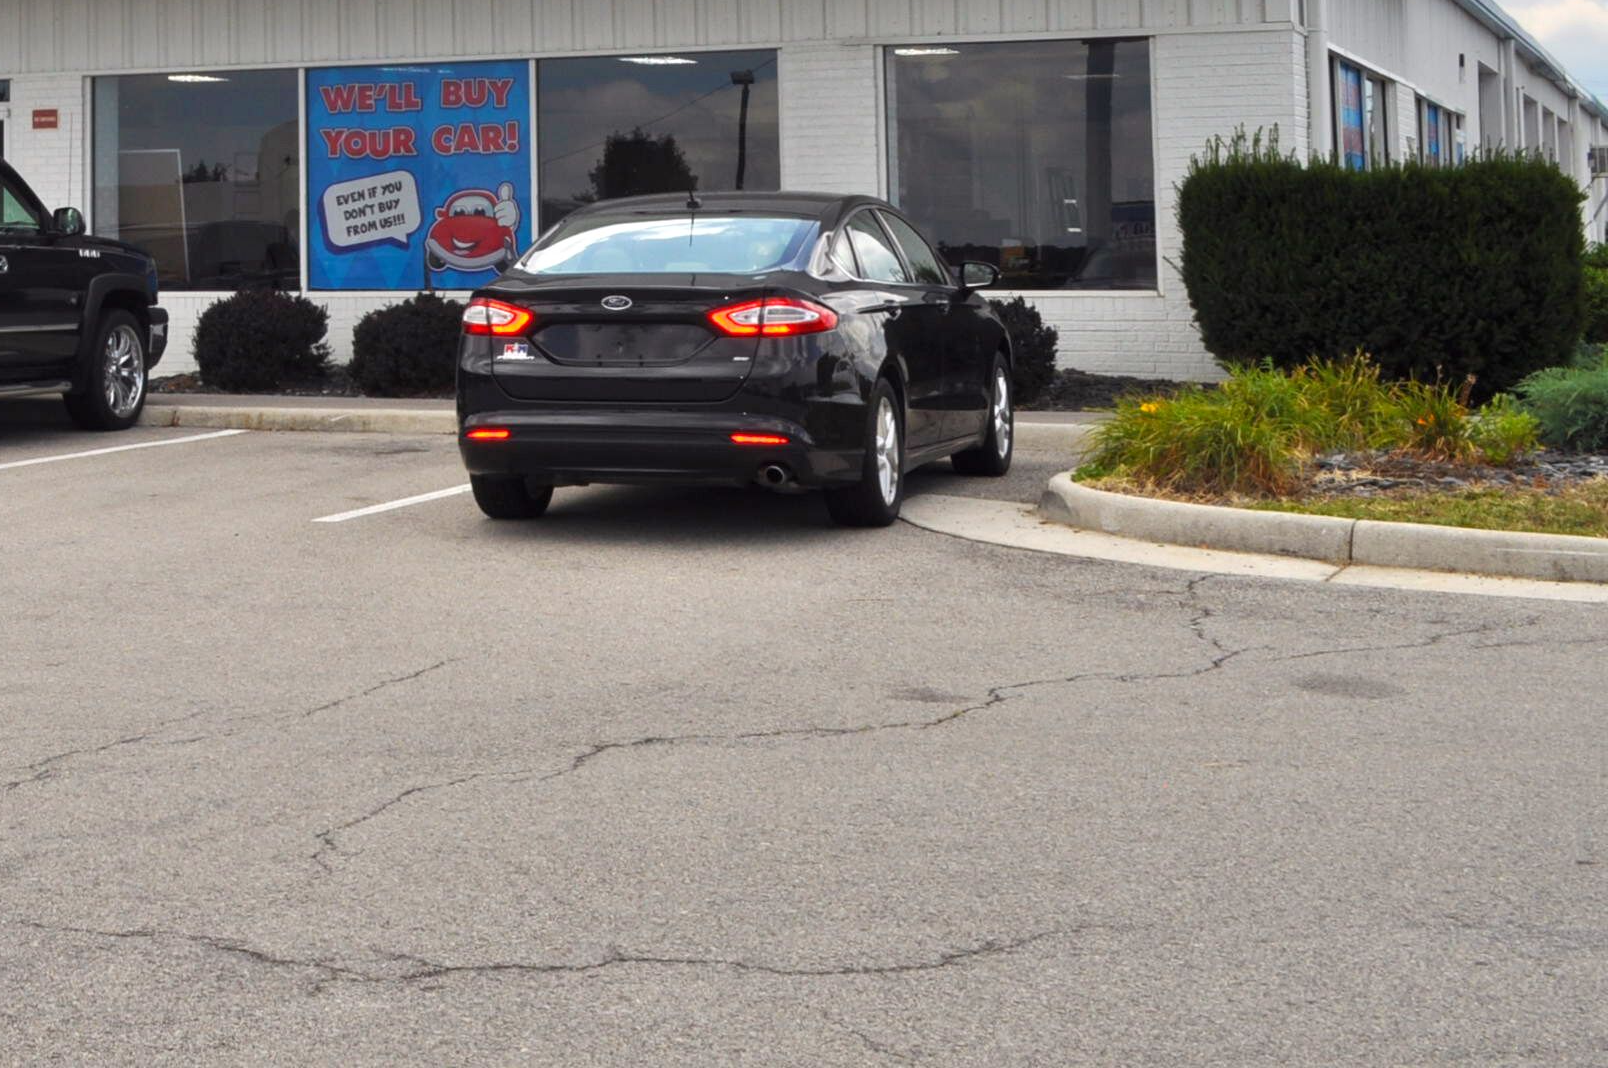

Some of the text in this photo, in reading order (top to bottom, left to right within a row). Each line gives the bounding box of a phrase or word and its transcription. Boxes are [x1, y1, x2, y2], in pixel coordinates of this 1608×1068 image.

[320, 79, 514, 114] WE'LL BUY
[320, 121, 520, 159] YOUR CAR!
[336, 189, 365, 206] EVEN
[381, 181, 402, 196] YOU
[344, 198, 400, 221] DON'T BUY
[346, 213, 406, 237] FROM US!!!
